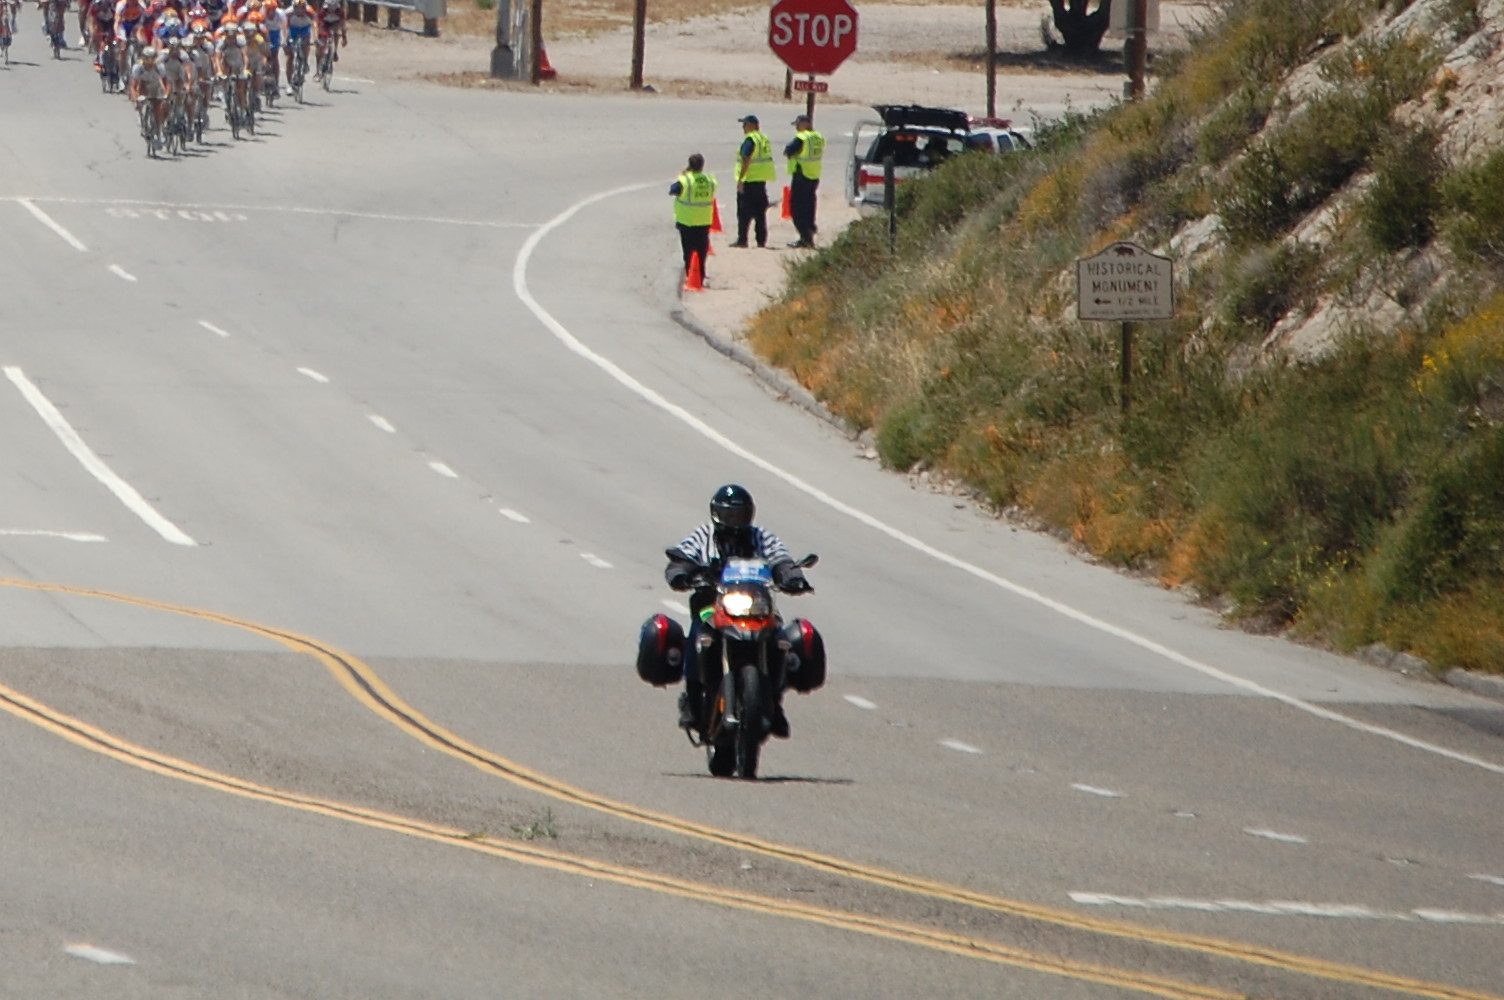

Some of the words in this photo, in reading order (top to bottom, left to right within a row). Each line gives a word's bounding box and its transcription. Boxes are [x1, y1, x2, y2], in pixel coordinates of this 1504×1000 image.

[773, 12, 853, 49] STOP
[1087, 262, 1161, 276] HISTORICAL
[1092, 280, 1159, 293] MONUMENT
